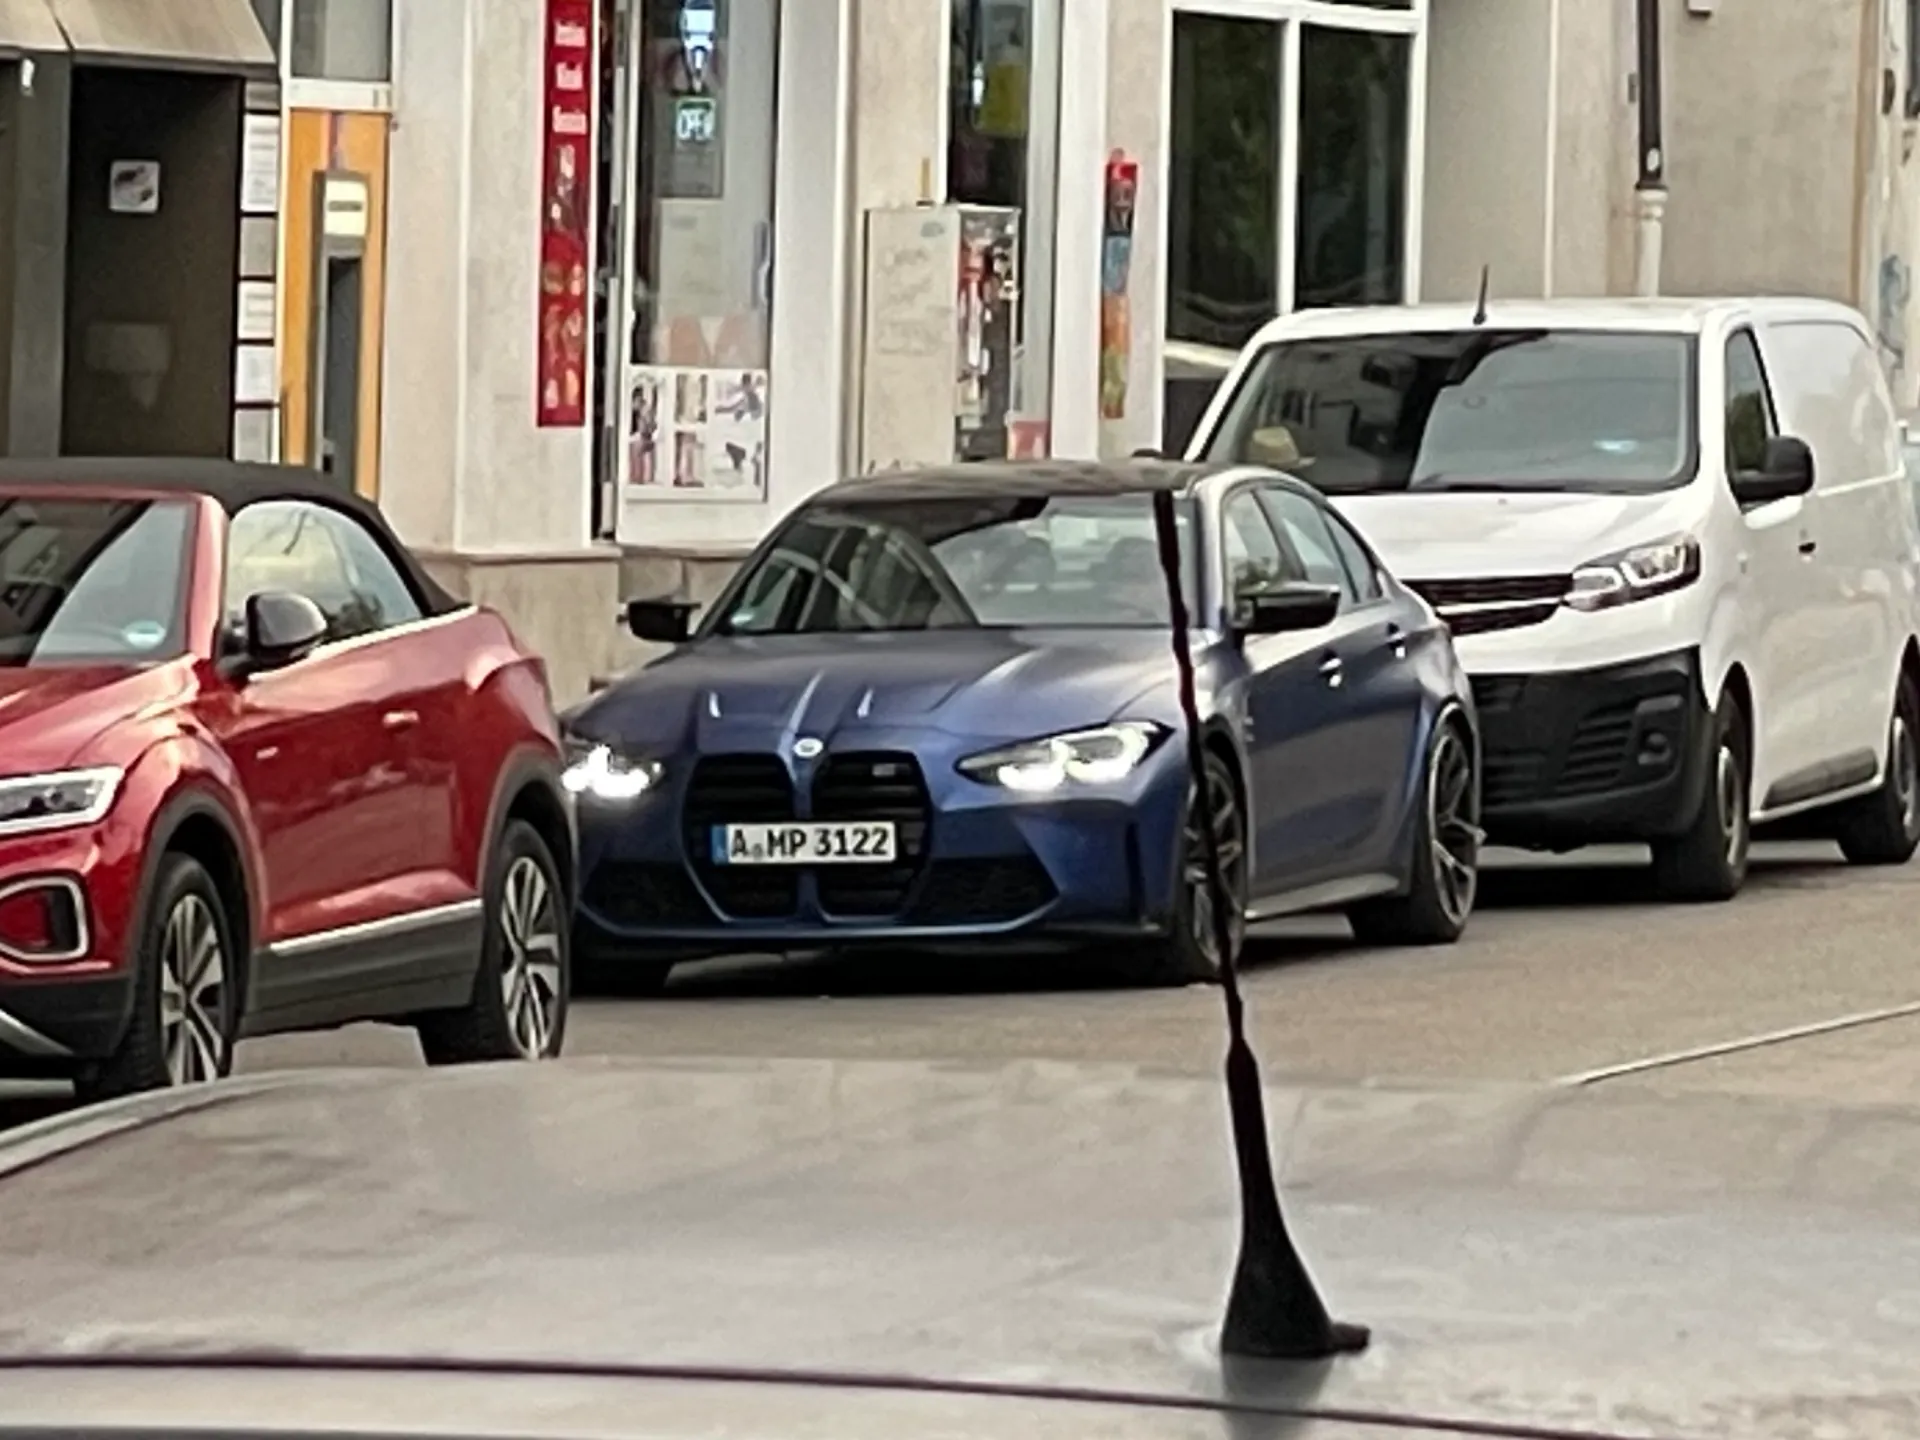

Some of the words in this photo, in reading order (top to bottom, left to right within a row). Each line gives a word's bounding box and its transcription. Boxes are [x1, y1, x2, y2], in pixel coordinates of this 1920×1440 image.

[732, 829, 747, 857] A
[767, 829, 807, 857] MP
[815, 827, 889, 857] 3122
